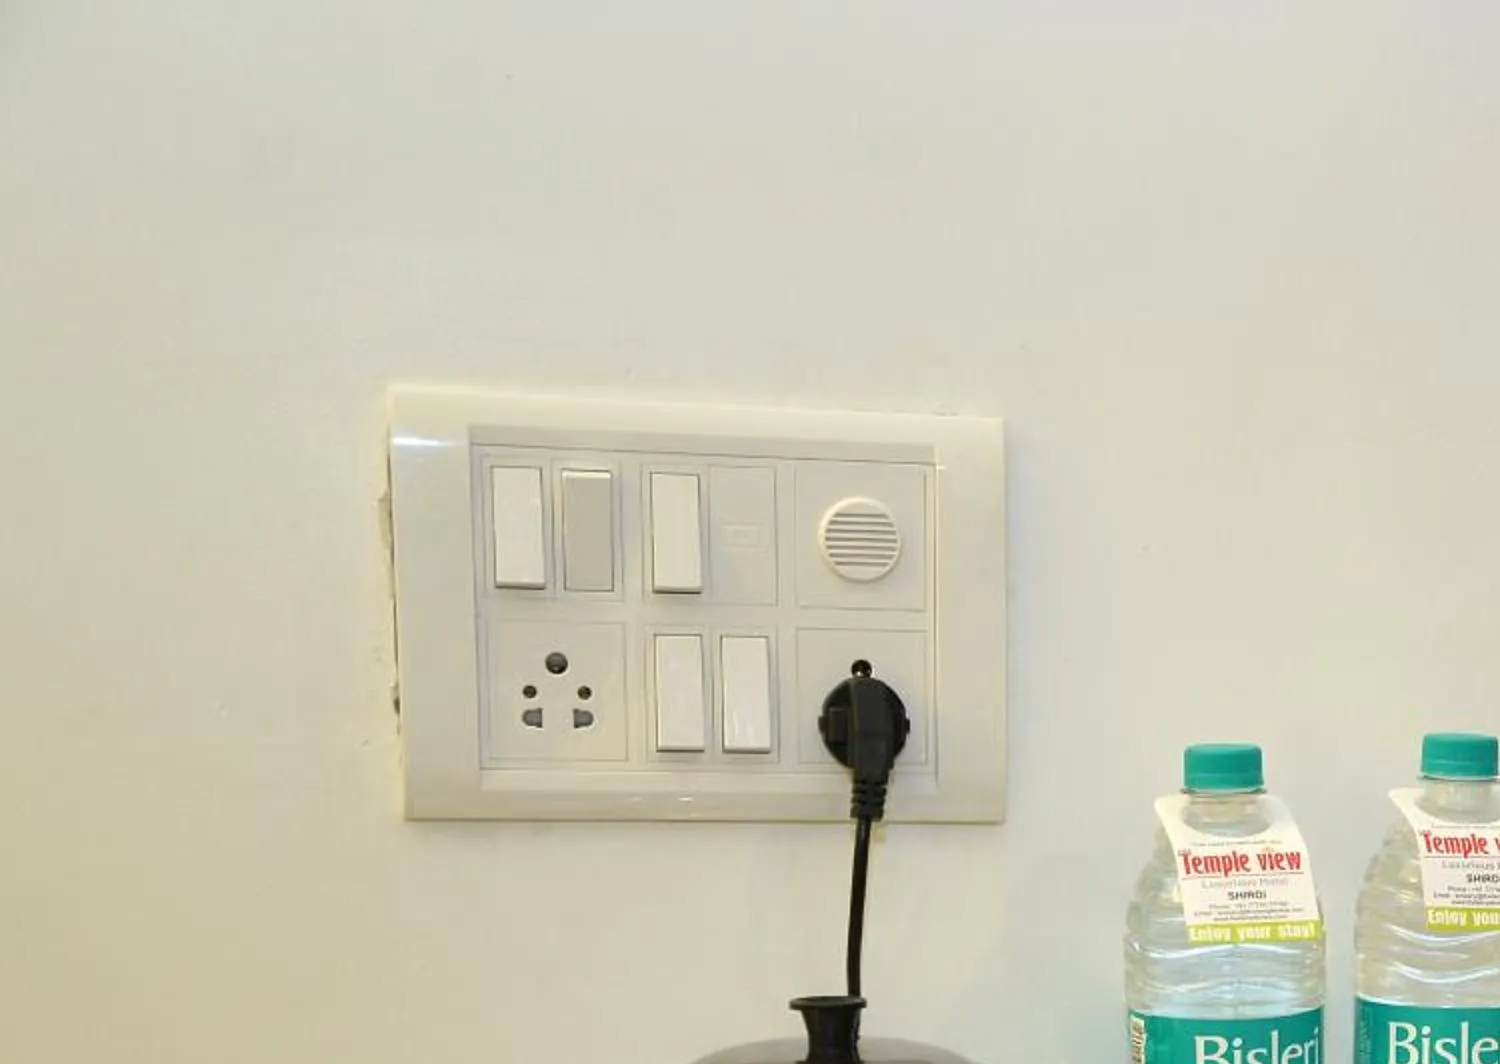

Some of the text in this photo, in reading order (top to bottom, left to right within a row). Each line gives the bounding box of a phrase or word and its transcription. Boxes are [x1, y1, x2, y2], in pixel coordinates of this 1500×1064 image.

[1424, 832, 1489, 858] Temple
[1182, 850, 1301, 877] Temple view
[1428, 909, 1468, 925] Enjoy
[1190, 922, 1315, 942] Enjoy your stay!
